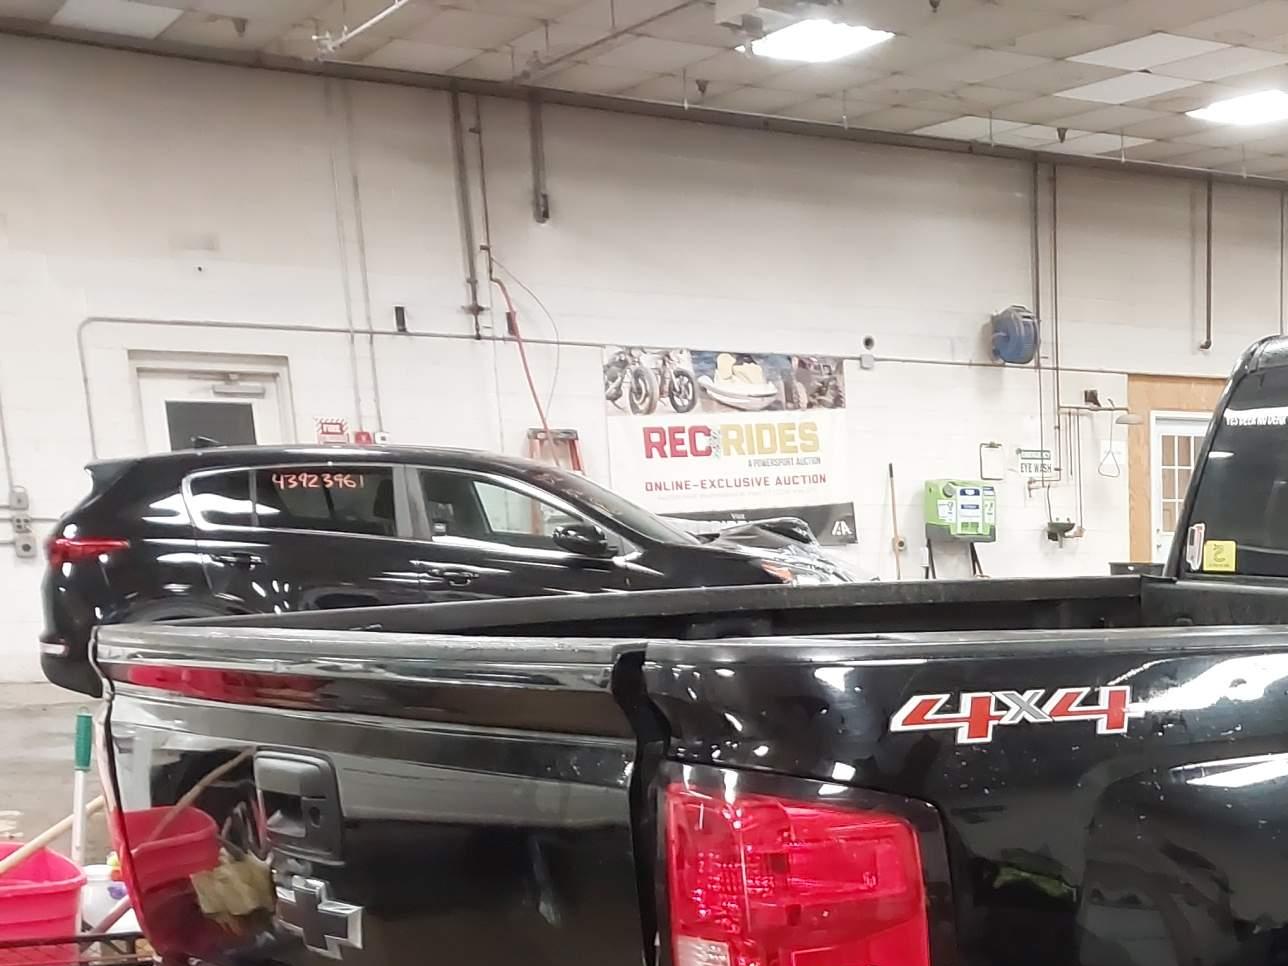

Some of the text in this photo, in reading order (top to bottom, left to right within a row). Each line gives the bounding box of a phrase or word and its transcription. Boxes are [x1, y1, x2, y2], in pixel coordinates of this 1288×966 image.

[643, 421, 820, 459] REC RIDES
[796, 457, 822, 466] AUCTION
[1020, 462, 1052, 473] EYE WASH
[271, 472, 364, 490] 43923961
[645, 473, 827, 492] ONLINE-EXCLUSIVE AUCTION
